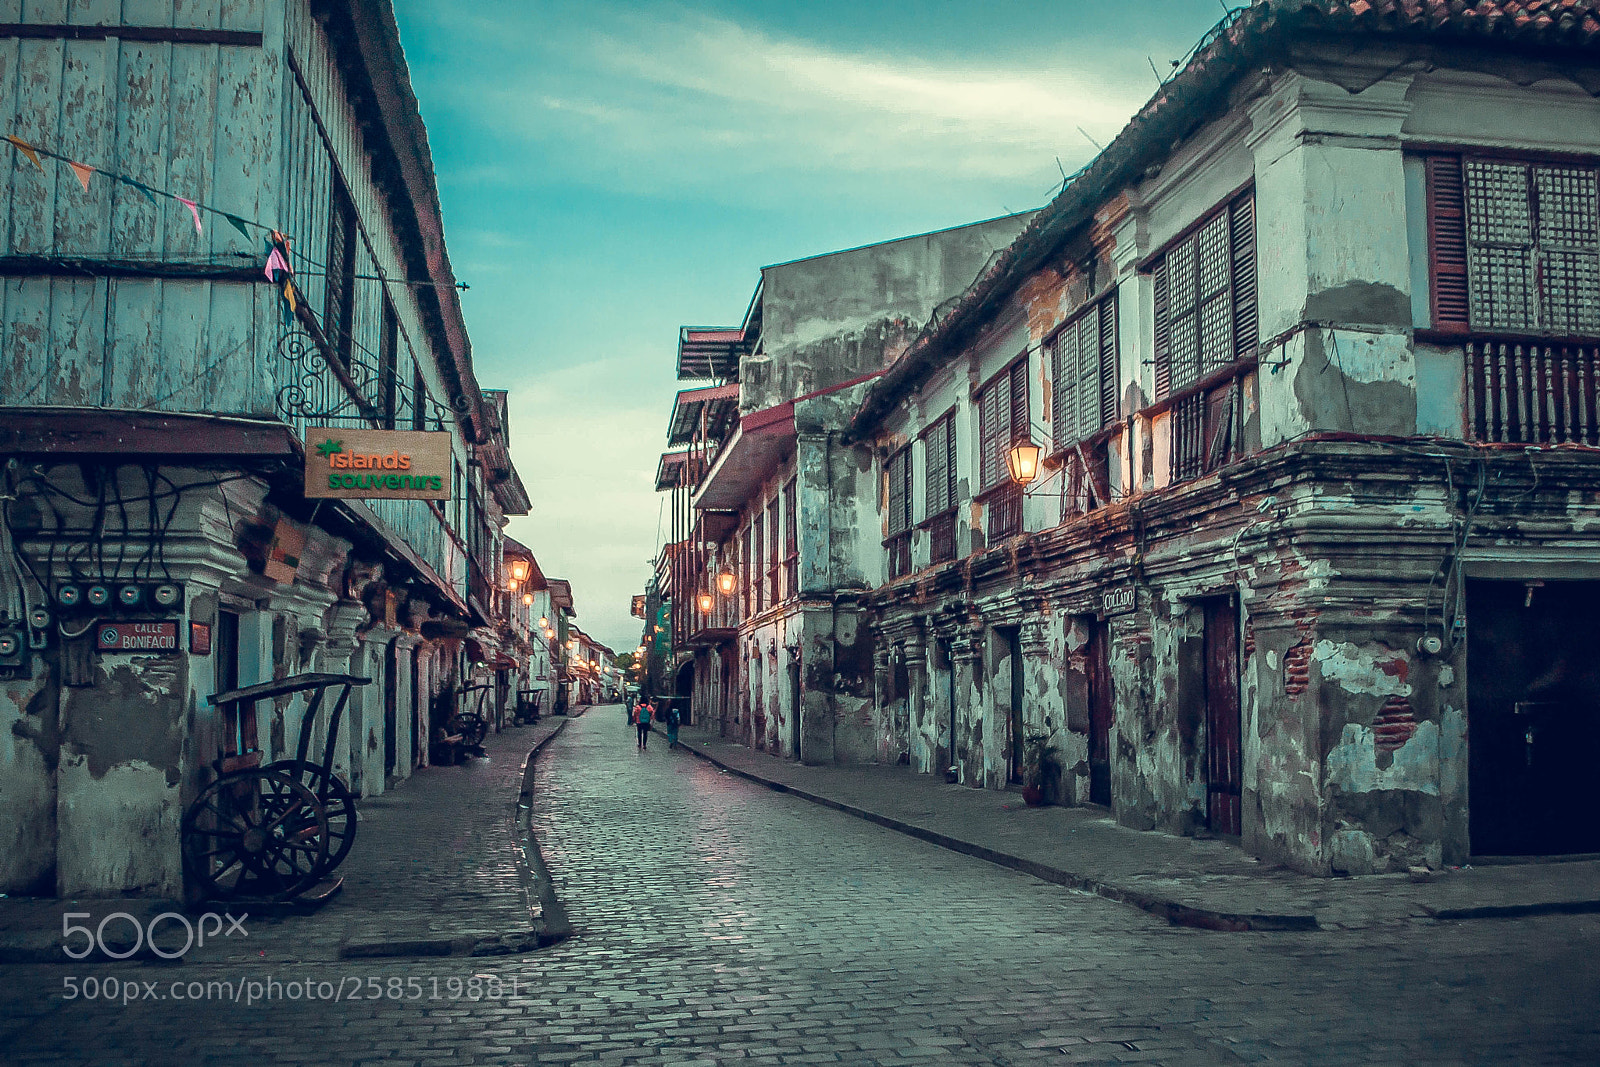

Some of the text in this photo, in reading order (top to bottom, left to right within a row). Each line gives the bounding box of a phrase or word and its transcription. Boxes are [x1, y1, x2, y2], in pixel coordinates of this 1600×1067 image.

[329, 449, 411, 470] islands
[328, 473, 442, 490] souvenirs
[134, 623, 163, 633] CALLE
[122, 635, 175, 649] BONIFACIO
